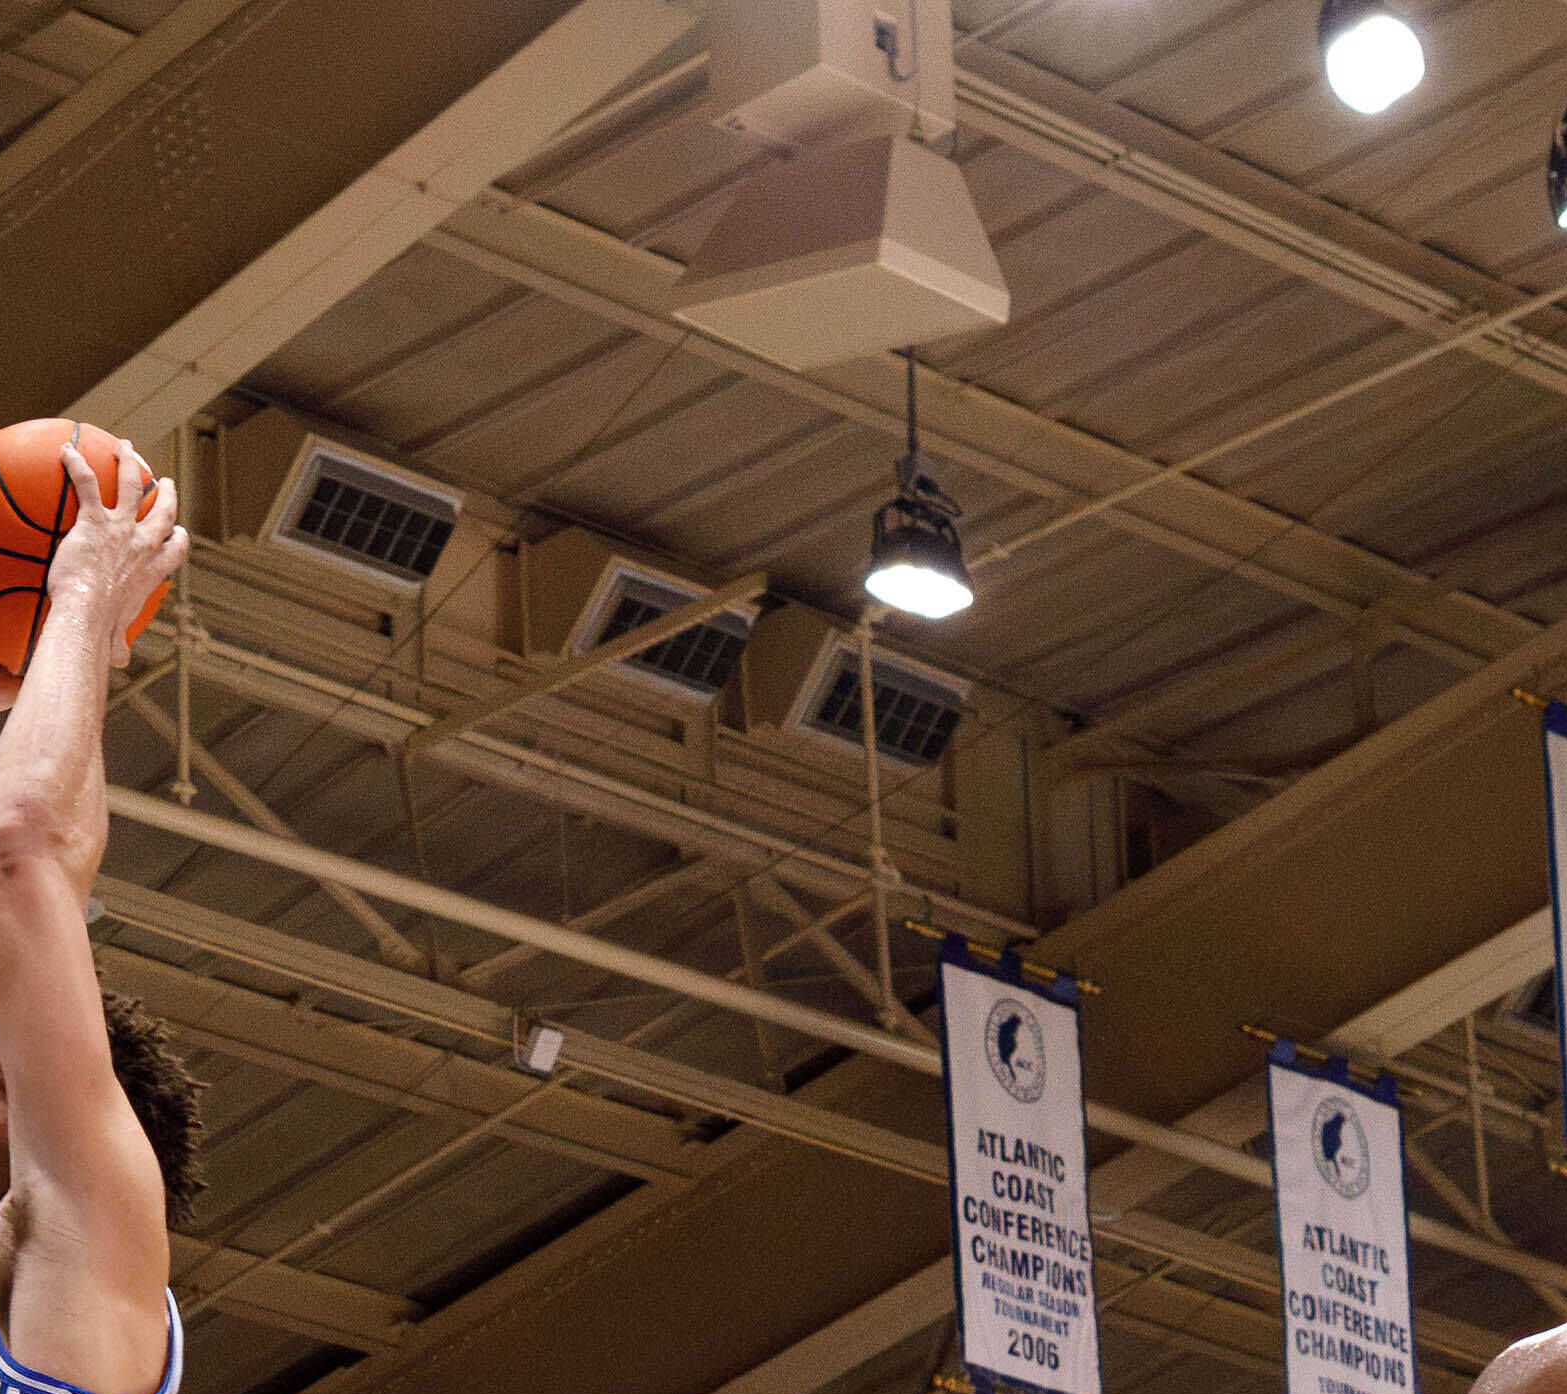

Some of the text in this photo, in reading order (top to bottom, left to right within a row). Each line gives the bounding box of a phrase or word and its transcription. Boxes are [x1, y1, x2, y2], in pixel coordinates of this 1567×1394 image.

[978, 1128, 1065, 1184] ATLANTIC
[992, 1171, 1054, 1215] COAST
[963, 1196, 1090, 1264] CONFERENCE
[1304, 1223, 1390, 1276] ATLANTIC
[971, 1235, 1087, 1298] CHAMPIONS
[1320, 1262, 1378, 1307] COAST
[1007, 1330, 1060, 1371] 2006
[1289, 1290, 1409, 1355] CONFERENCE
[1295, 1328, 1407, 1388] CHAMPIONS
